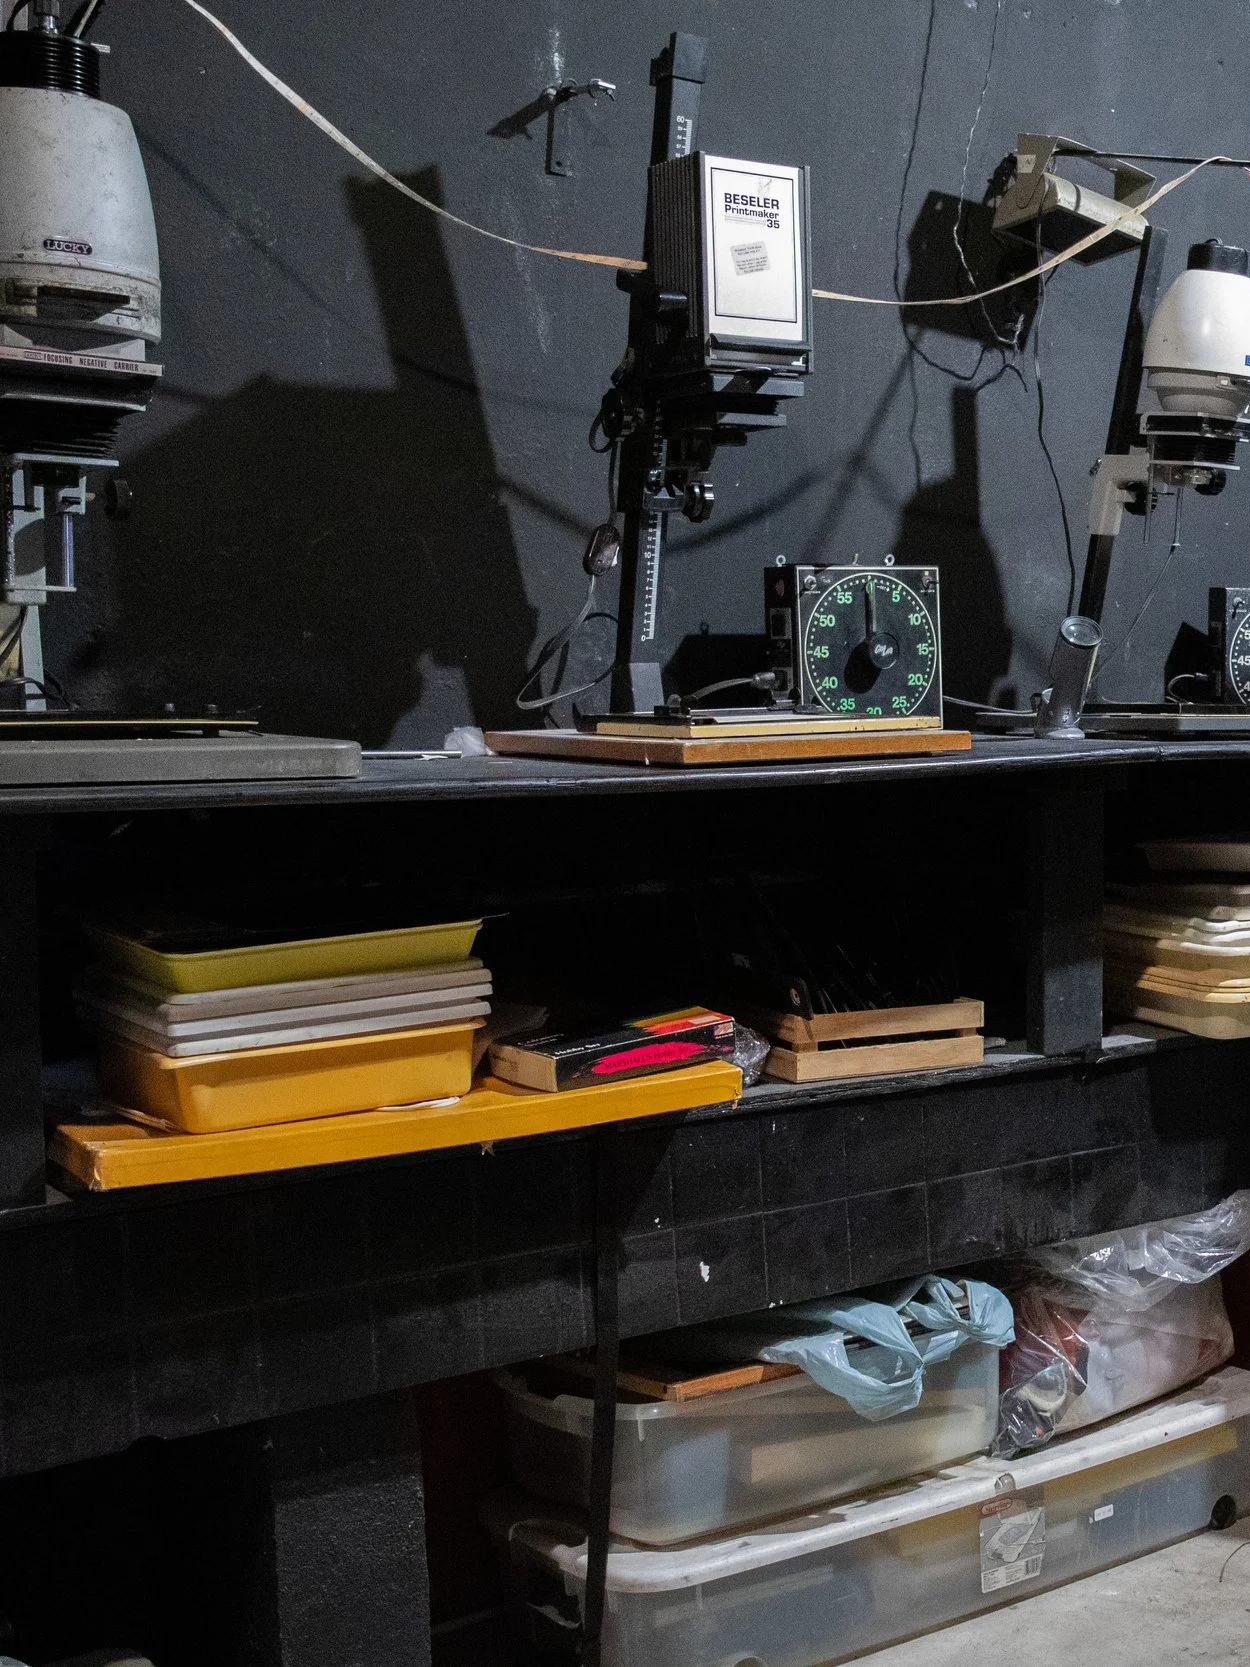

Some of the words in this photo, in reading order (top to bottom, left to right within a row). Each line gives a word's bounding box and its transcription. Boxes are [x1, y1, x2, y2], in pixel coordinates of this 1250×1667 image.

[724, 193, 779, 210] BESELER
[725, 204, 779, 219] Printmaker
[766, 220, 780, 229] 35
[45, 240, 90, 255] LUCKY
[43, 353, 73, 364] FOCUSING
[79, 358, 107, 368] NEGATIVE
[114, 361, 139, 372] CARRIER
[837, 592, 852, 603] 55
[892, 591, 900, 602] 5
[819, 615, 836, 627] 50
[908, 614, 921, 625] 10
[814, 646, 829, 658] 45
[917, 644, 930, 655] 15
[822, 677, 838, 689] 40
[908, 674, 923, 686] 20
[840, 699, 855, 711] 35
[892, 696, 908, 708] 25
